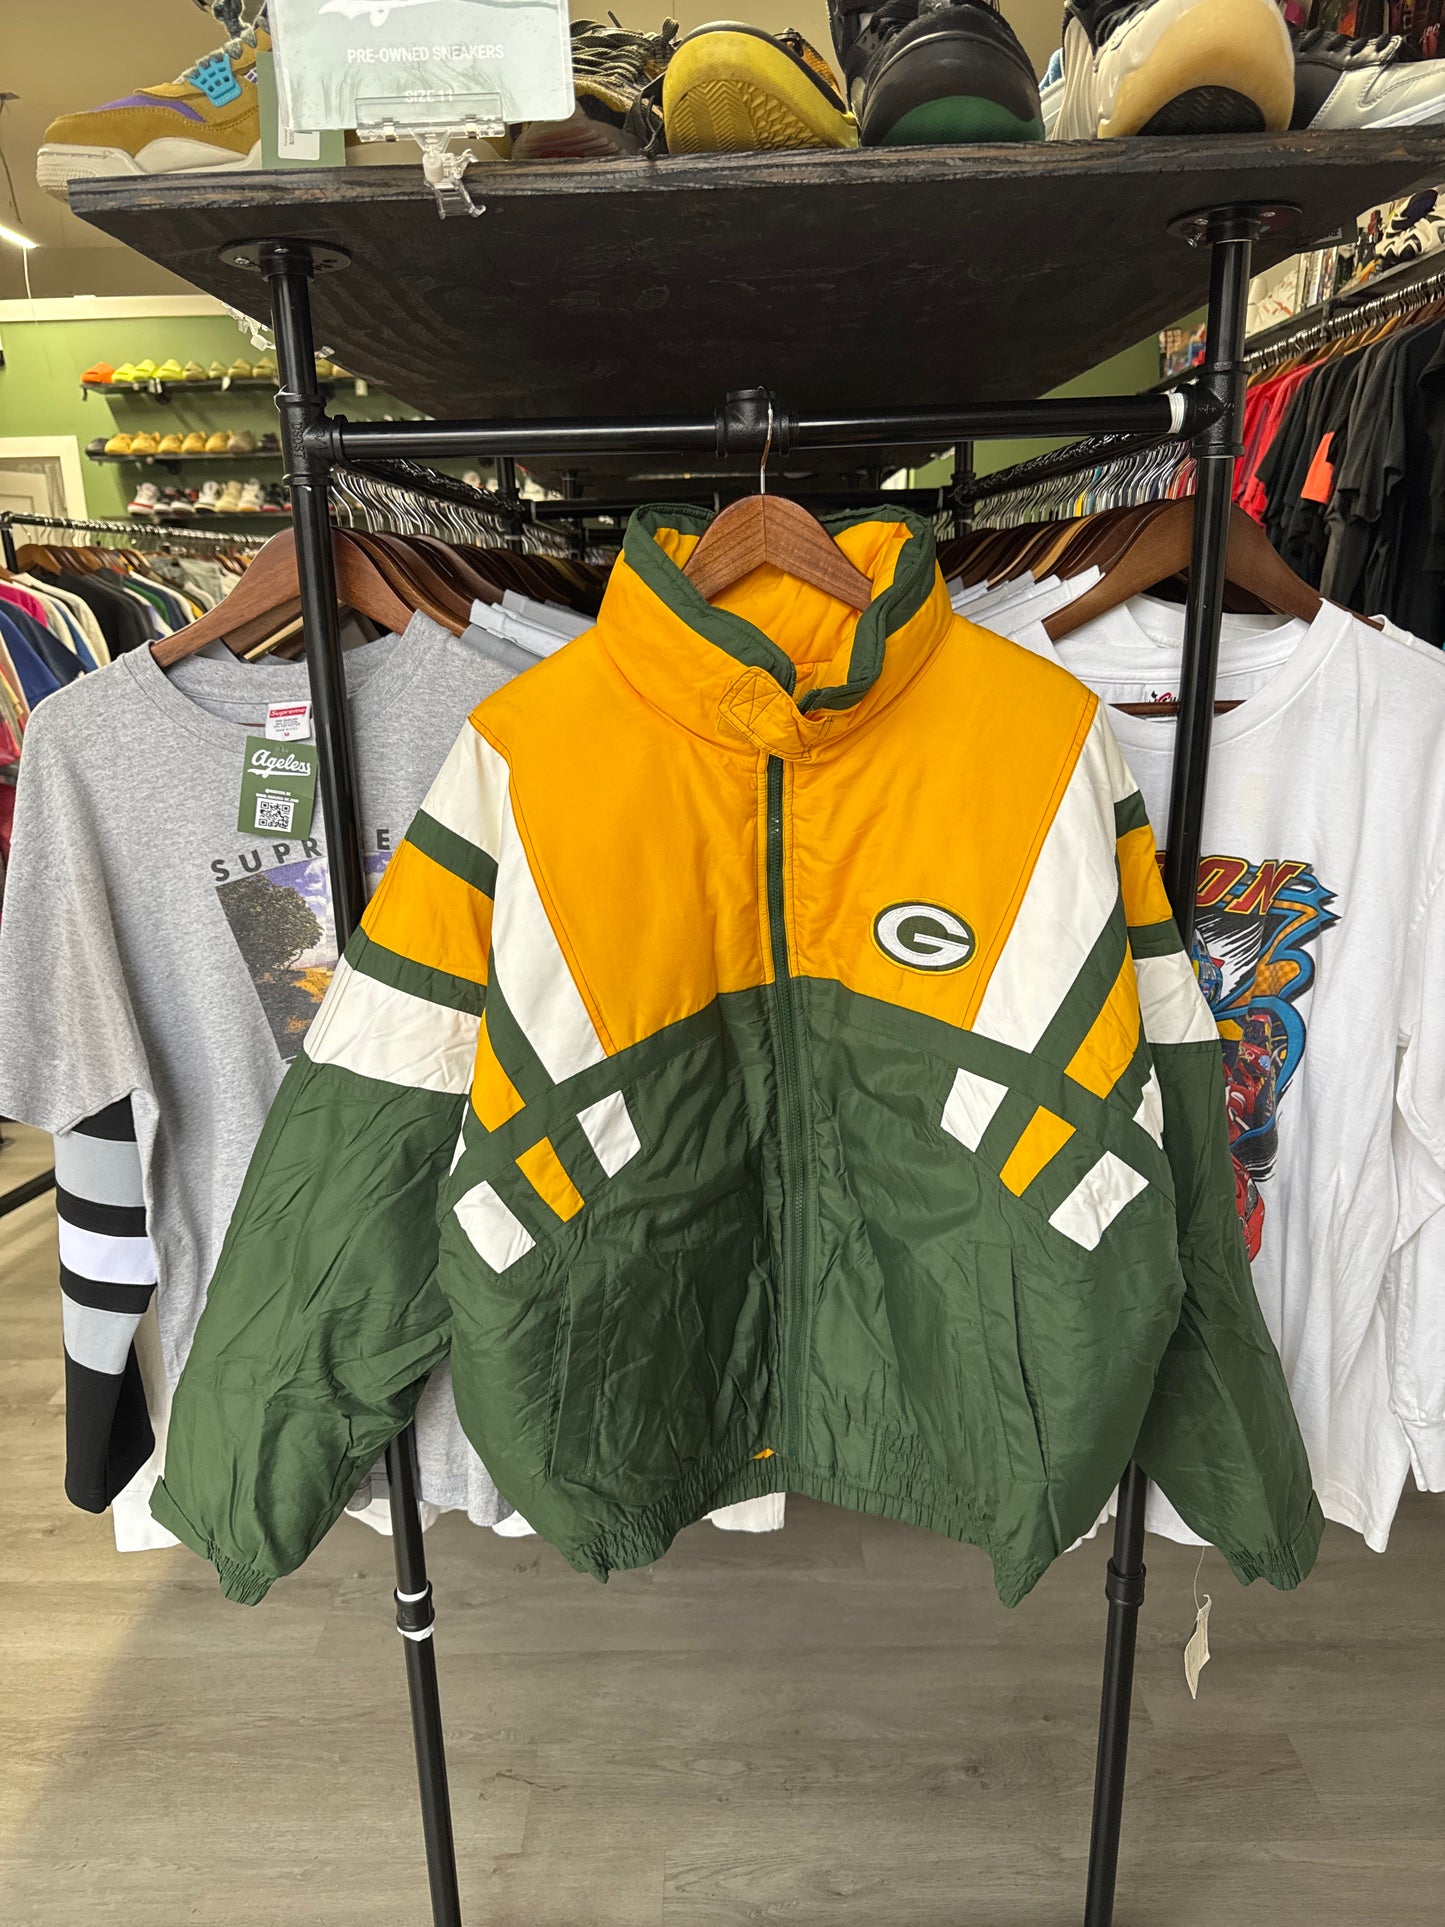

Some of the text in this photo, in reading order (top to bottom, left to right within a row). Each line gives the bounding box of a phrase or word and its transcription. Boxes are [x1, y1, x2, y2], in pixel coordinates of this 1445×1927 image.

[347, 44, 505, 63] PRE-OWNED SNEAKERS
[404, 90, 435, 103] SIZE
[270, 707, 306, 717] Supreme
[247, 749, 311, 778] Ageless
[210, 829, 390, 882] SUPRE
[877, 905, 970, 966] G
